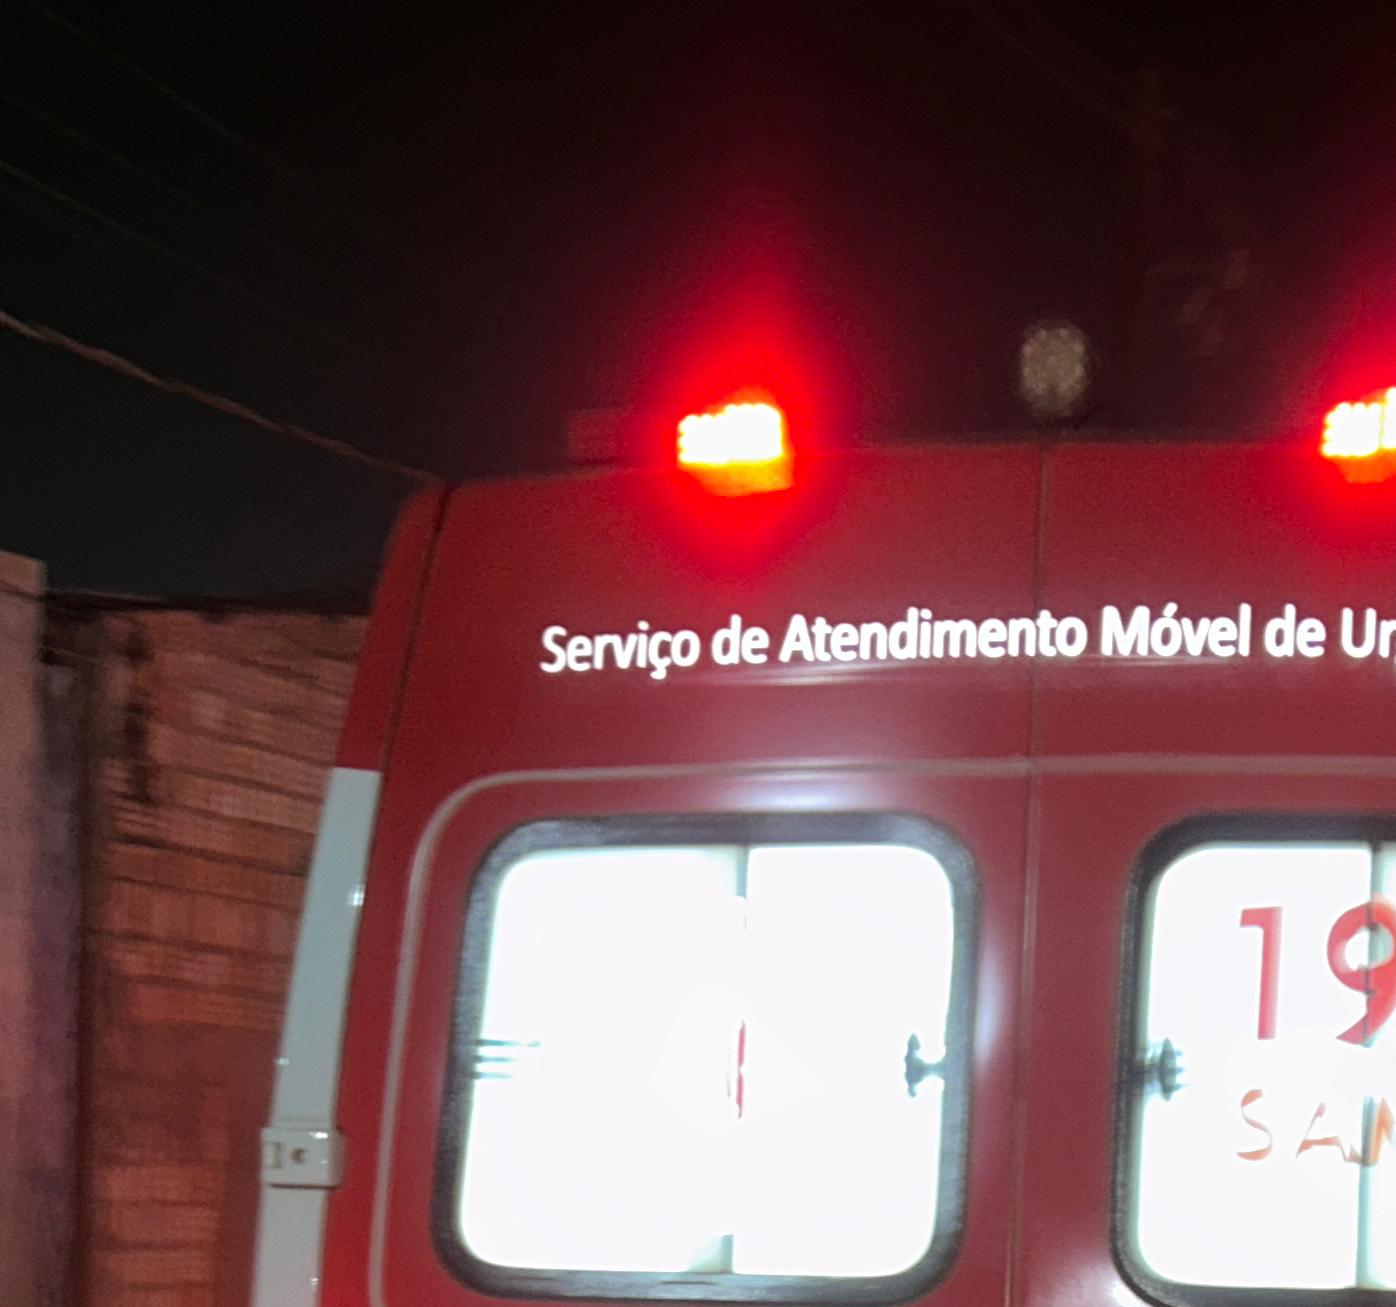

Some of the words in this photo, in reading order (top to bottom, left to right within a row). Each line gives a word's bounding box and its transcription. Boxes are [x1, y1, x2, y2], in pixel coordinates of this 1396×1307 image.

[540, 620, 700, 680] Serviço
[711, 613, 771, 665] de
[778, 605, 1087, 663] Atendimento
[1100, 602, 1252, 657] Móvel
[1264, 602, 1327, 658] de
